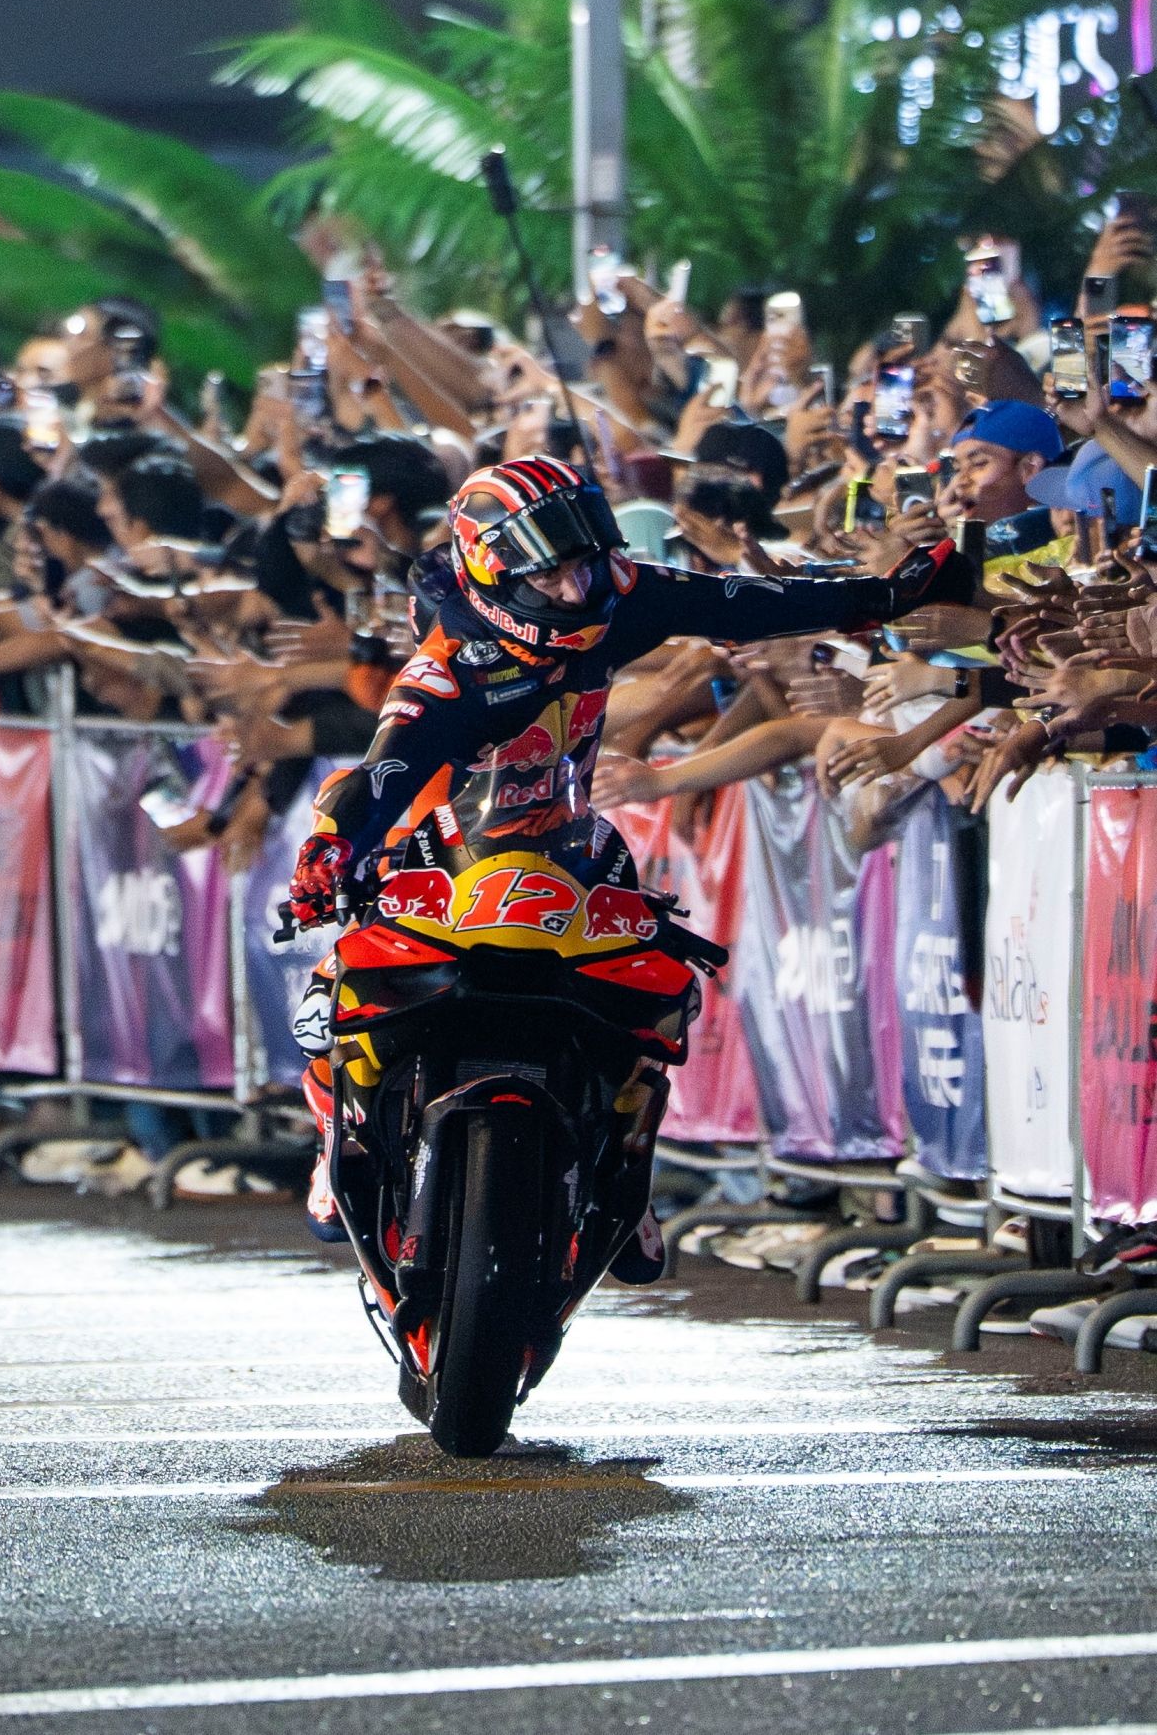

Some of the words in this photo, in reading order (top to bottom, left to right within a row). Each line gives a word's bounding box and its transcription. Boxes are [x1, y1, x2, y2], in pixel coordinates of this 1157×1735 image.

[496, 767, 555, 808] Red
[434, 804, 459, 841] MOTUL
[418, 839, 436, 867] BAJAJ
[452, 867, 581, 934] 12
